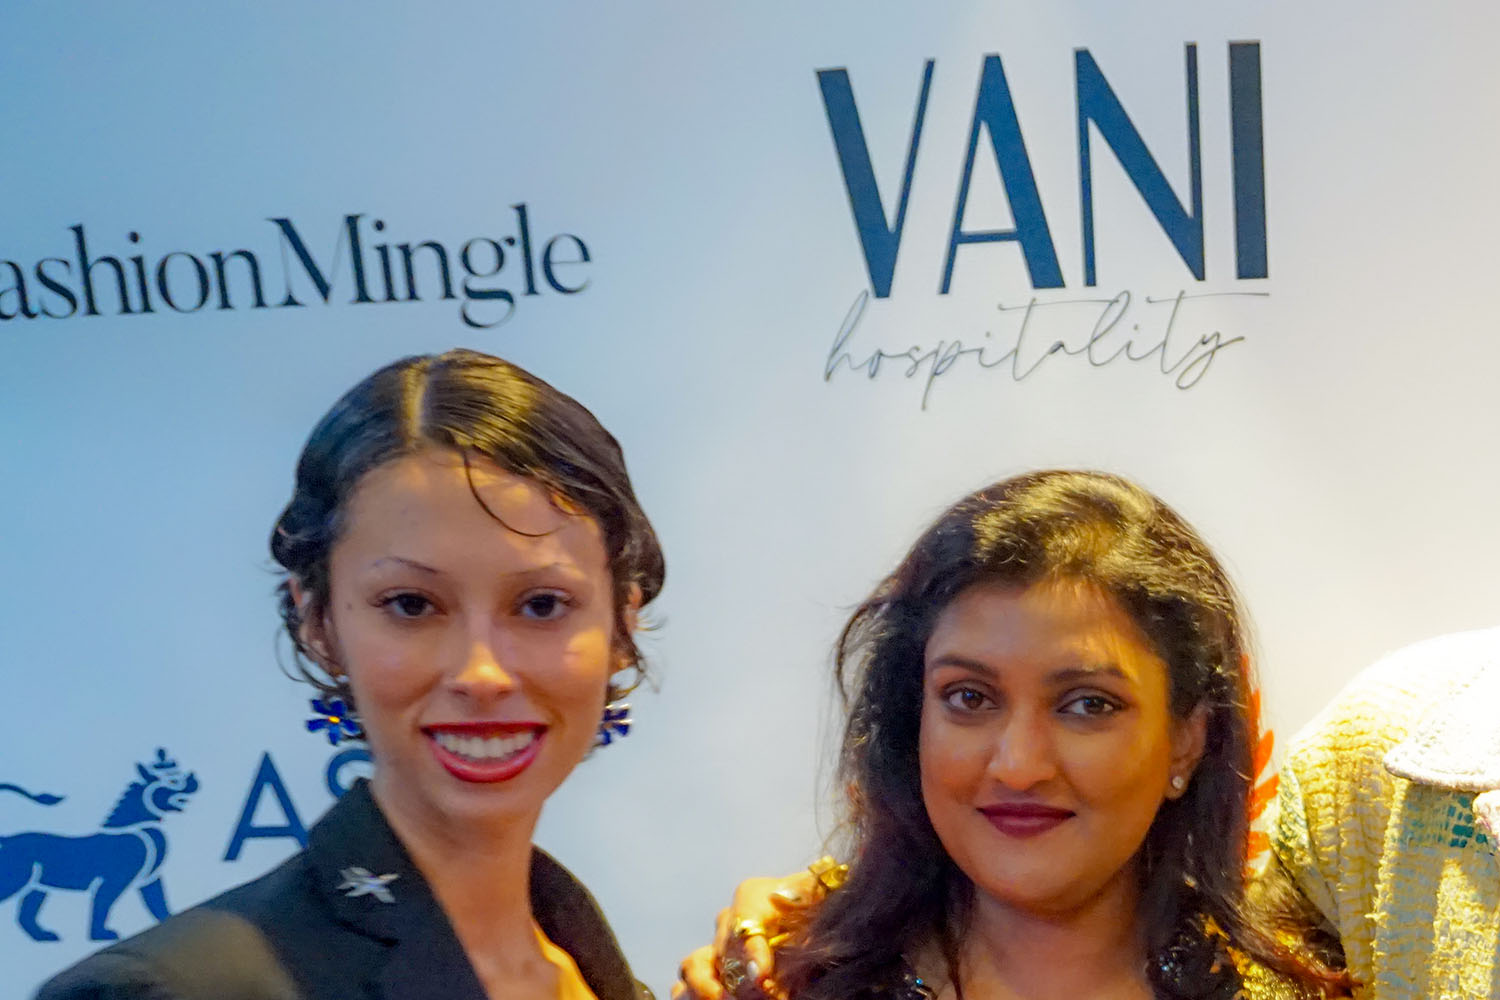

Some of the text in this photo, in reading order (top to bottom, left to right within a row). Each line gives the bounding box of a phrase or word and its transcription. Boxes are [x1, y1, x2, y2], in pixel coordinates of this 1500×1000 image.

[815, 40, 1269, 298] VANI
[0, 203, 592, 329] ashionMingle
[824, 290, 1269, 412] hospitality
